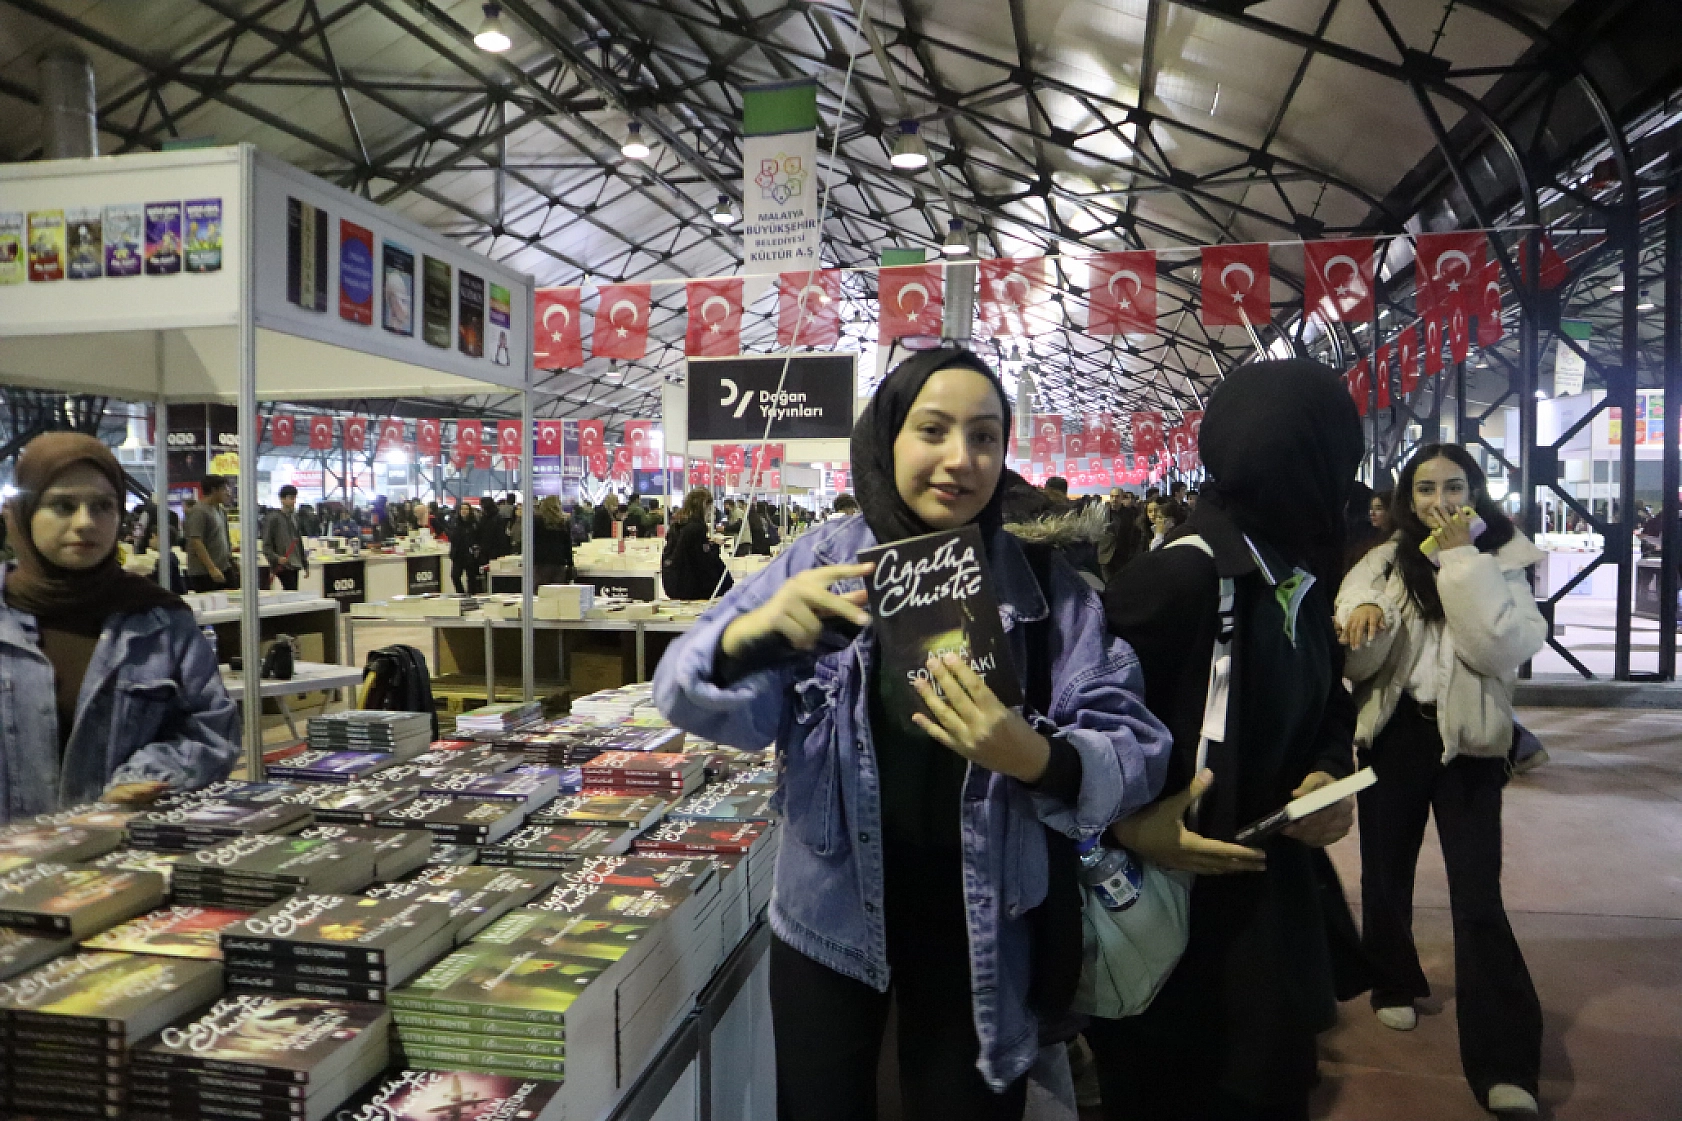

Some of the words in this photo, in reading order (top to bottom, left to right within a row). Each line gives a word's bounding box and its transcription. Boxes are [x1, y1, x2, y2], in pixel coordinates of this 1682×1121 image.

[750, 249, 792, 262] KÜLTÜR
[759, 390, 807, 405] Doğan
[759, 403, 823, 420] Yayınları
[873, 537, 975, 591] Agatha
[879, 565, 982, 617] Christie
